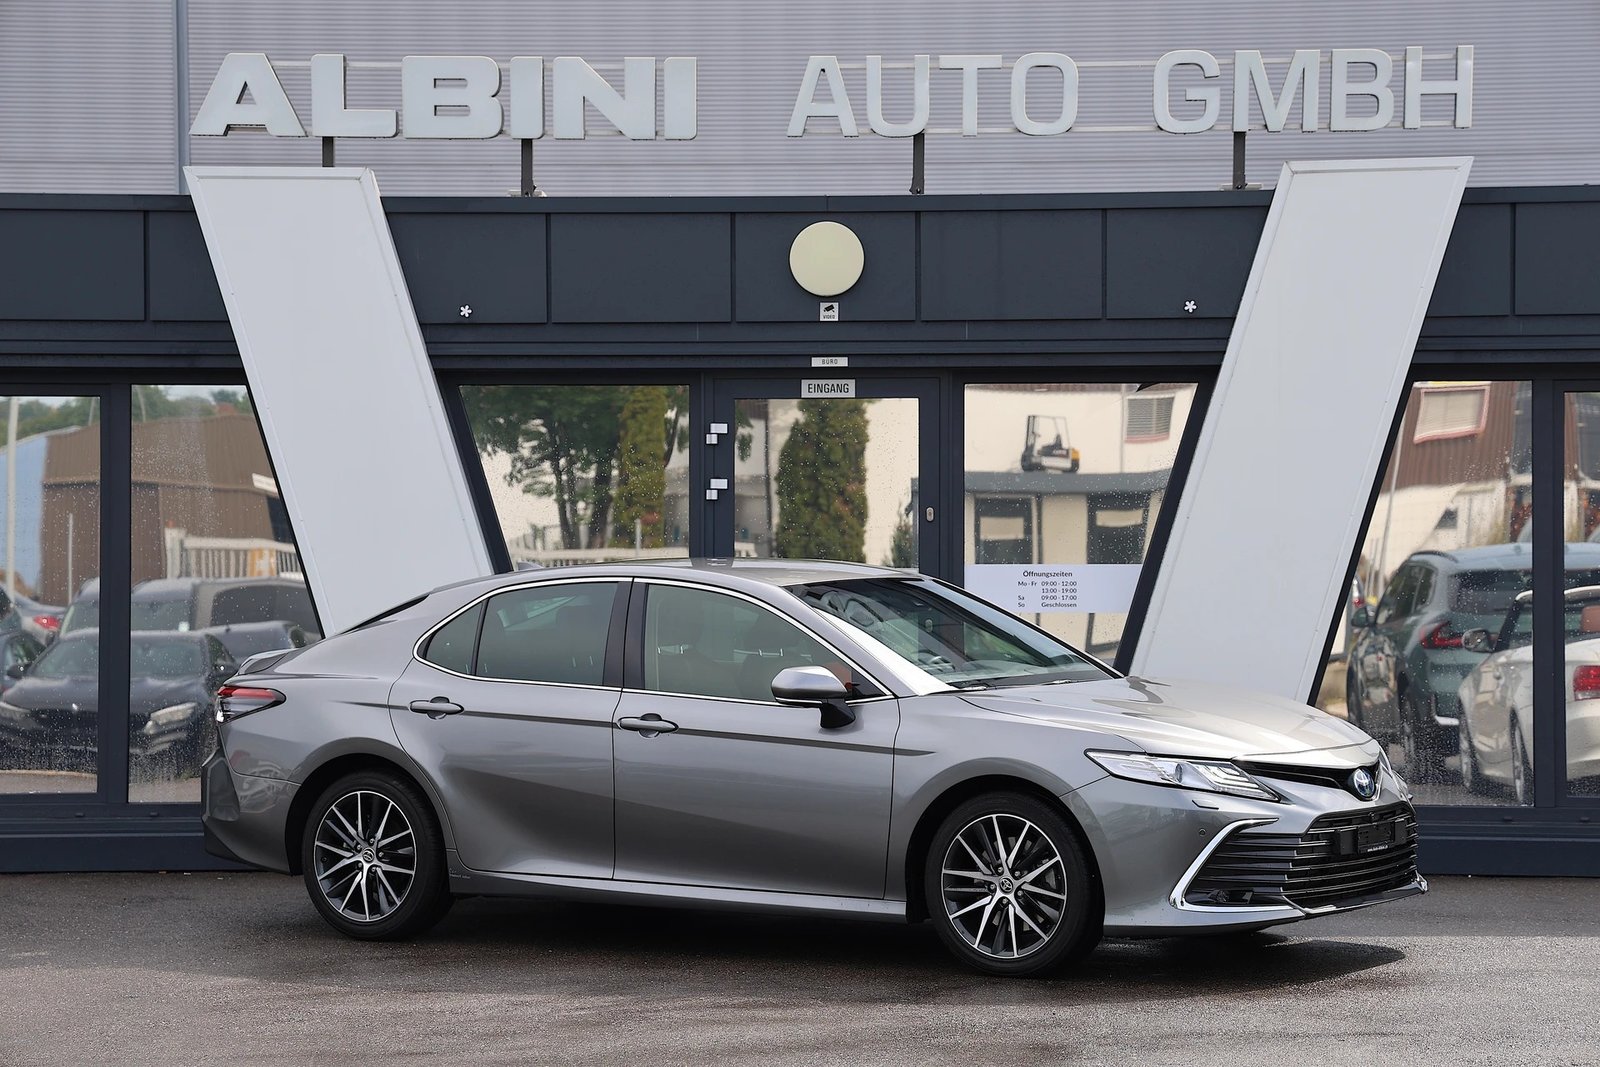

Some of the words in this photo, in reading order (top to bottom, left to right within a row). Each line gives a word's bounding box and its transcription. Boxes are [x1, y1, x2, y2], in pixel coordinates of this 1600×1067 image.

[188, 52, 698, 140] ALBINI
[787, 52, 1079, 137] AUTO
[1152, 45, 1474, 134] GMBH
[807, 383, 850, 394] EINGANG
[1022, 570, 1073, 578] Öffnungszeiten
